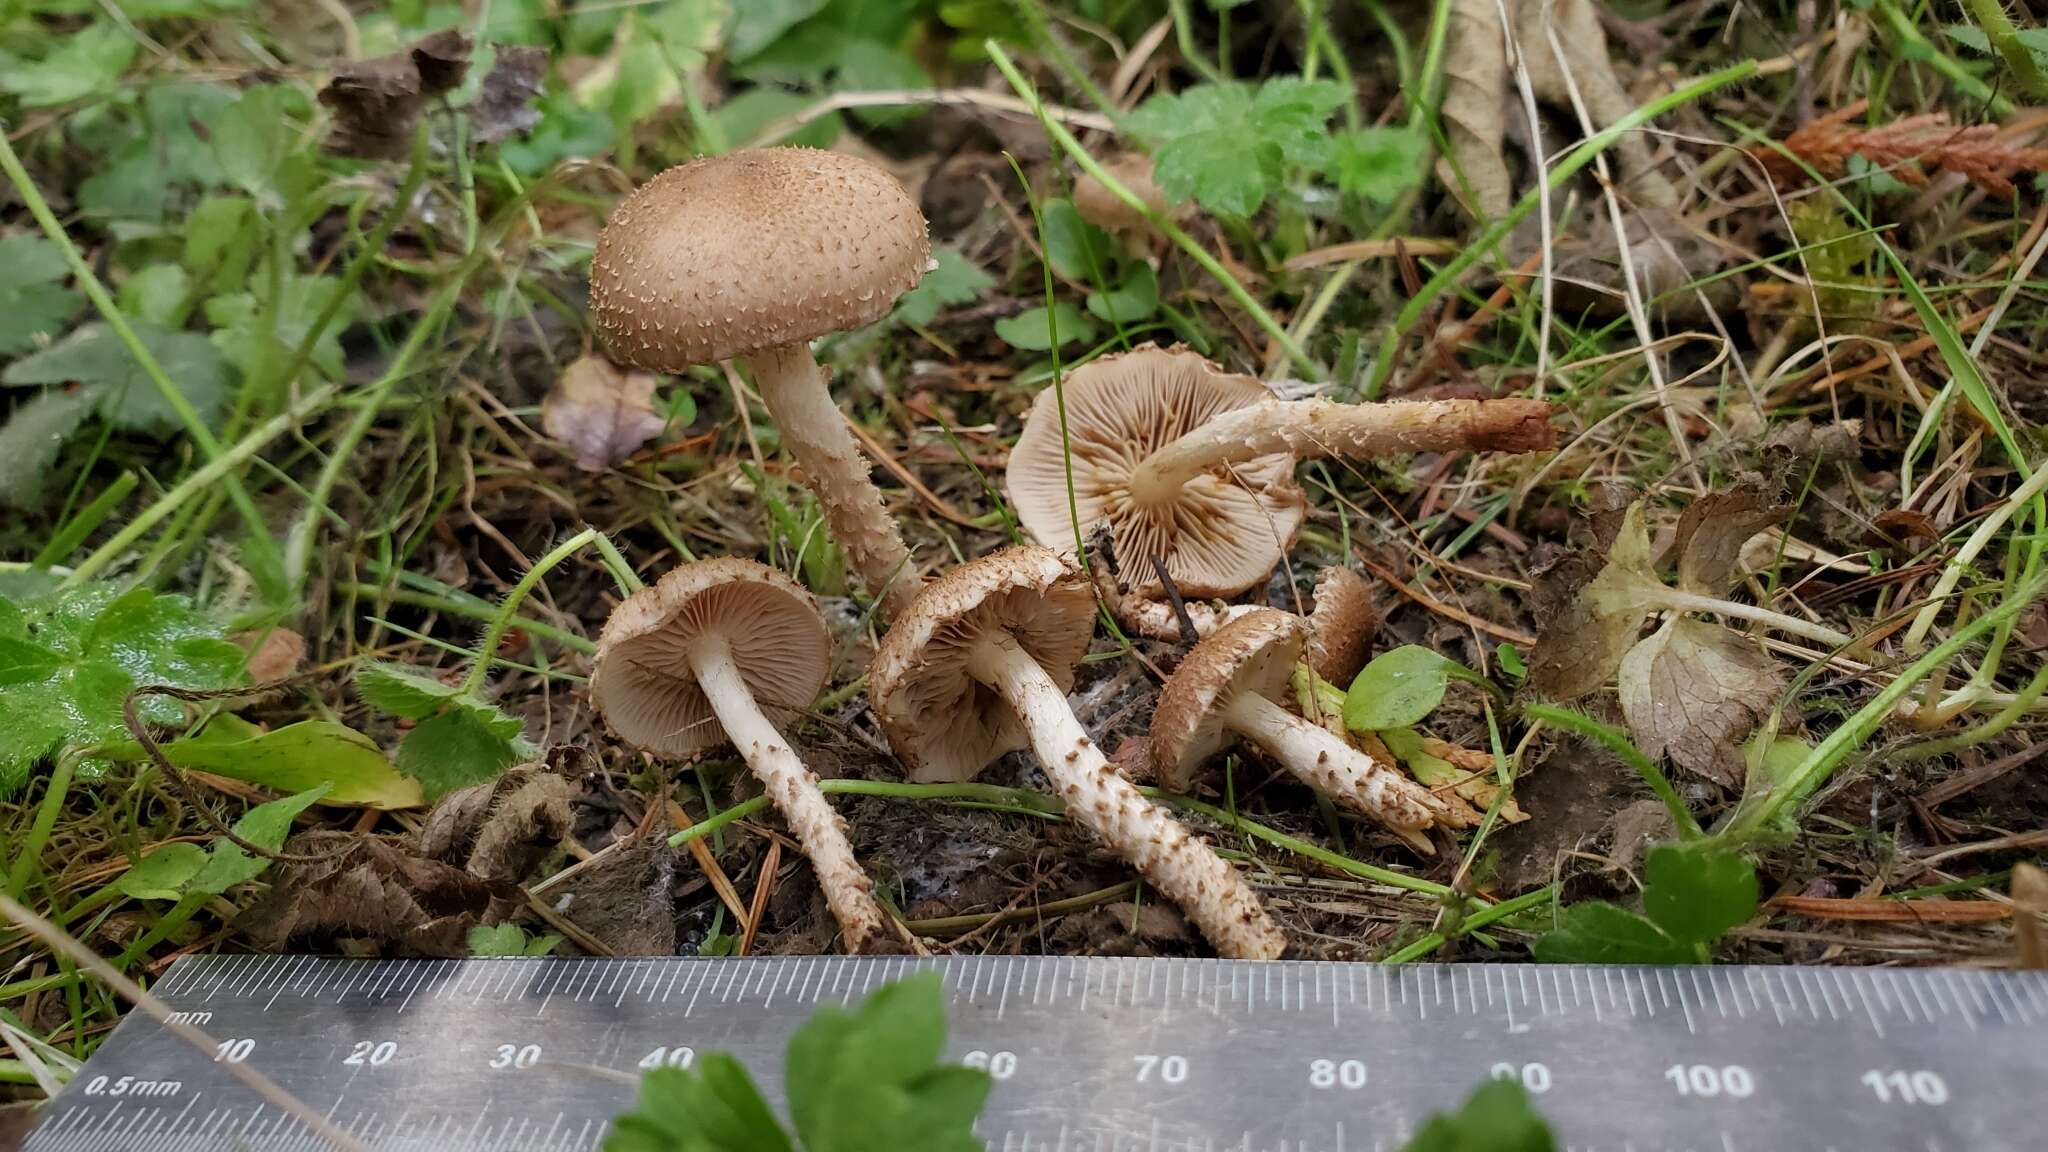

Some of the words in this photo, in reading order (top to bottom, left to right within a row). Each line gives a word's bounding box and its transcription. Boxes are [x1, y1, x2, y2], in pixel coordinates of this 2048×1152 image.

[163, 1009, 213, 1025] mm
[214, 1038, 256, 1063] 10
[342, 1041, 398, 1065] 20
[489, 1044, 542, 1069] 30
[638, 1045, 695, 1070] 40
[1134, 1054, 1189, 1083] 70
[1310, 1059, 1366, 1089] 80
[1664, 1064, 1755, 1098] 100
[1861, 1069, 1949, 1106] 110
[84, 1076, 182, 1097] 0.5mm
